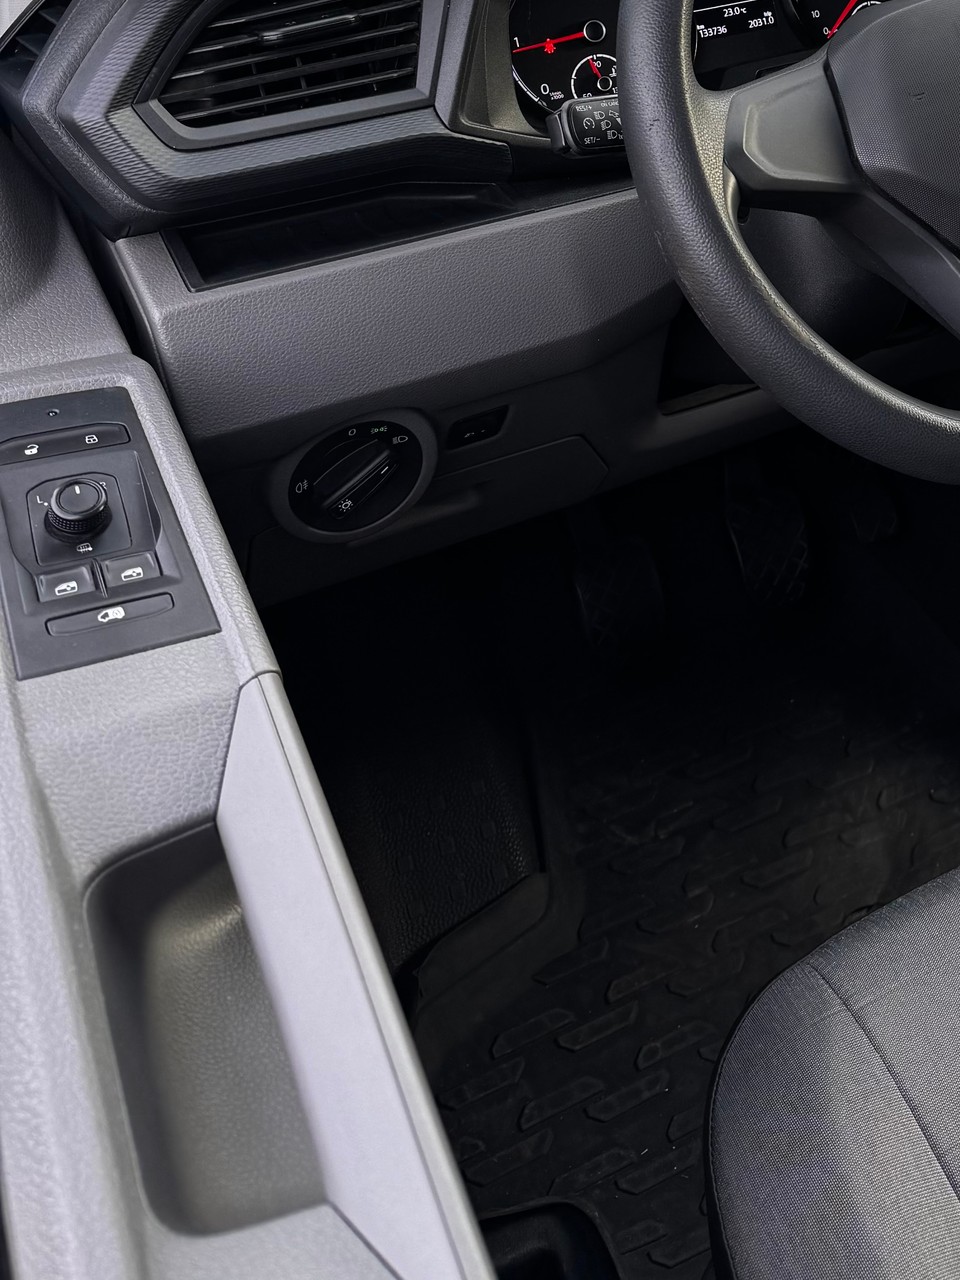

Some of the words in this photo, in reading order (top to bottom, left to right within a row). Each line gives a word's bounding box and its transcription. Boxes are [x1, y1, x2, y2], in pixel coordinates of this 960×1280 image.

[723, 7, 740, 17] 23.0
[811, 10, 820, 19] 10
[748, 16, 775, 29] 2031.0
[699, 25, 728, 38] 133736
[514, 37, 520, 48] 1
[541, 84, 549, 94] 0
[36, 495, 43, 504] L
